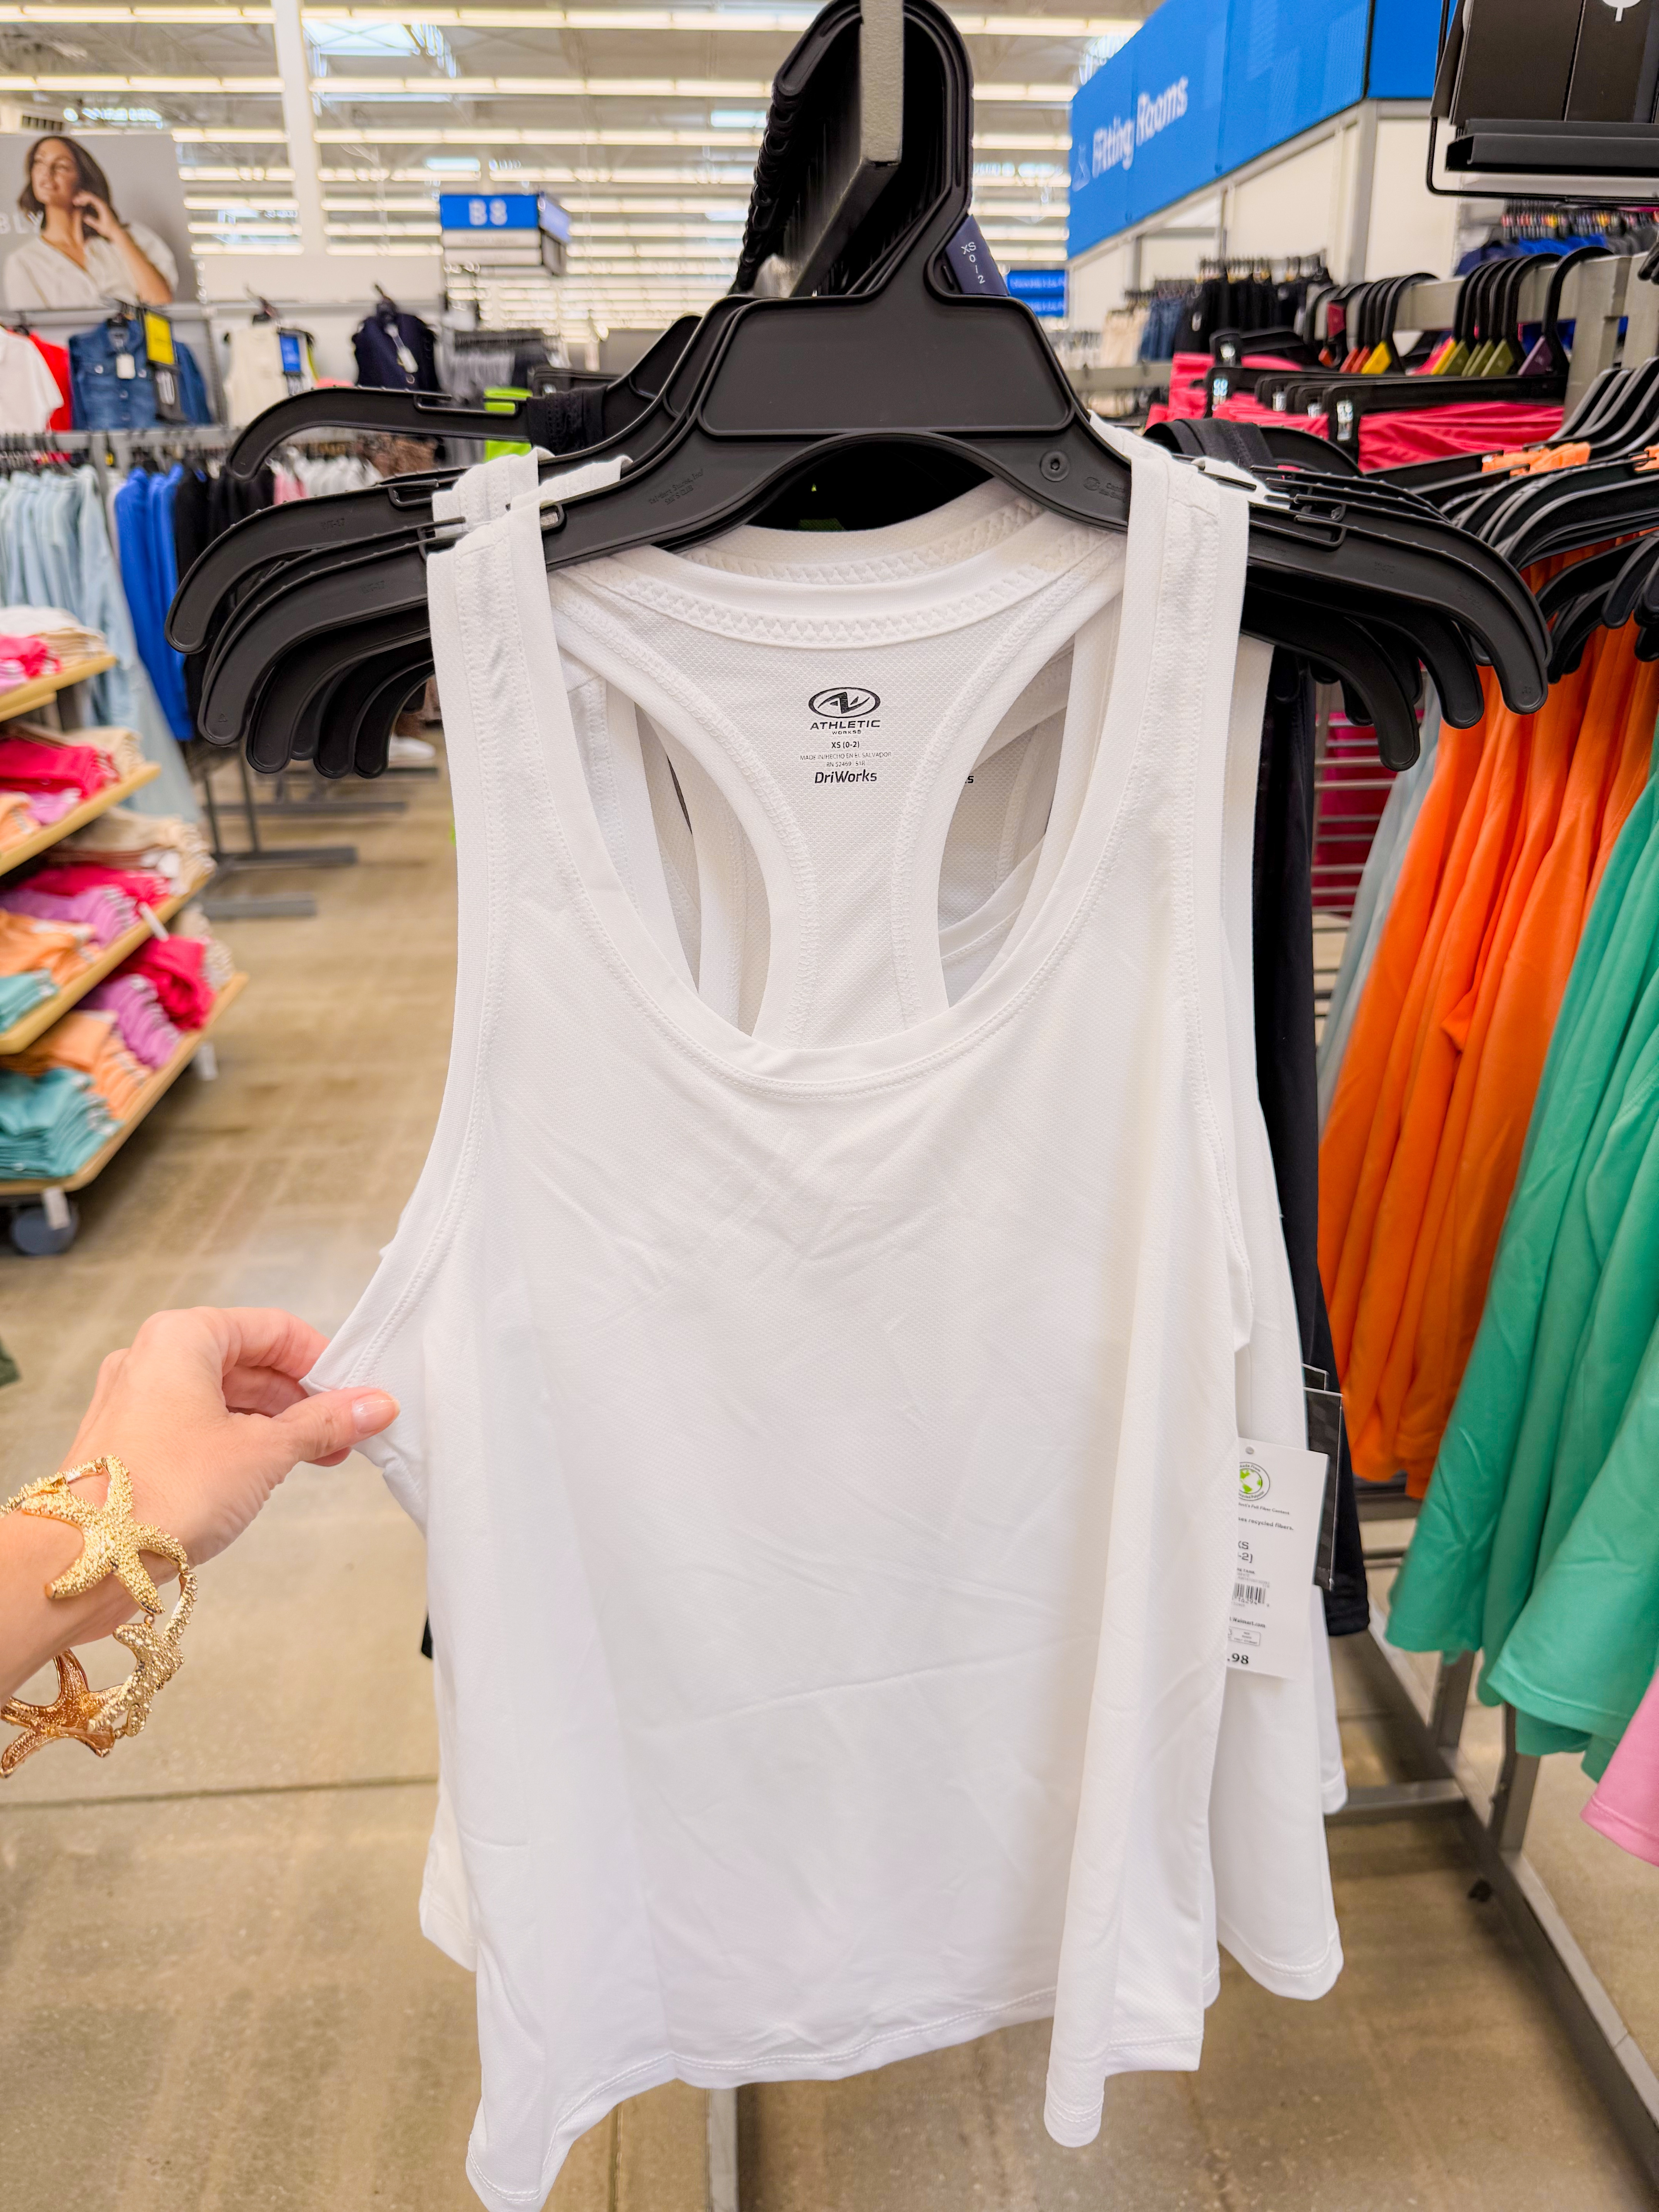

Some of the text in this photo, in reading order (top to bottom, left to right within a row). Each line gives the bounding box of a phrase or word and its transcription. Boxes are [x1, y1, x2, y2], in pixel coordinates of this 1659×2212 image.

[1092, 76, 1188, 179] Fitting Rooms
[961, 242, 976, 254] XS
[810, 720, 881, 730] ATHLETIC
[815, 769, 877, 783] DriWorks
[1248, 1519, 1273, 1527] recycled
[1237, 1552, 1253, 1563] -2)
[1227, 1652, 1249, 1664] .98
